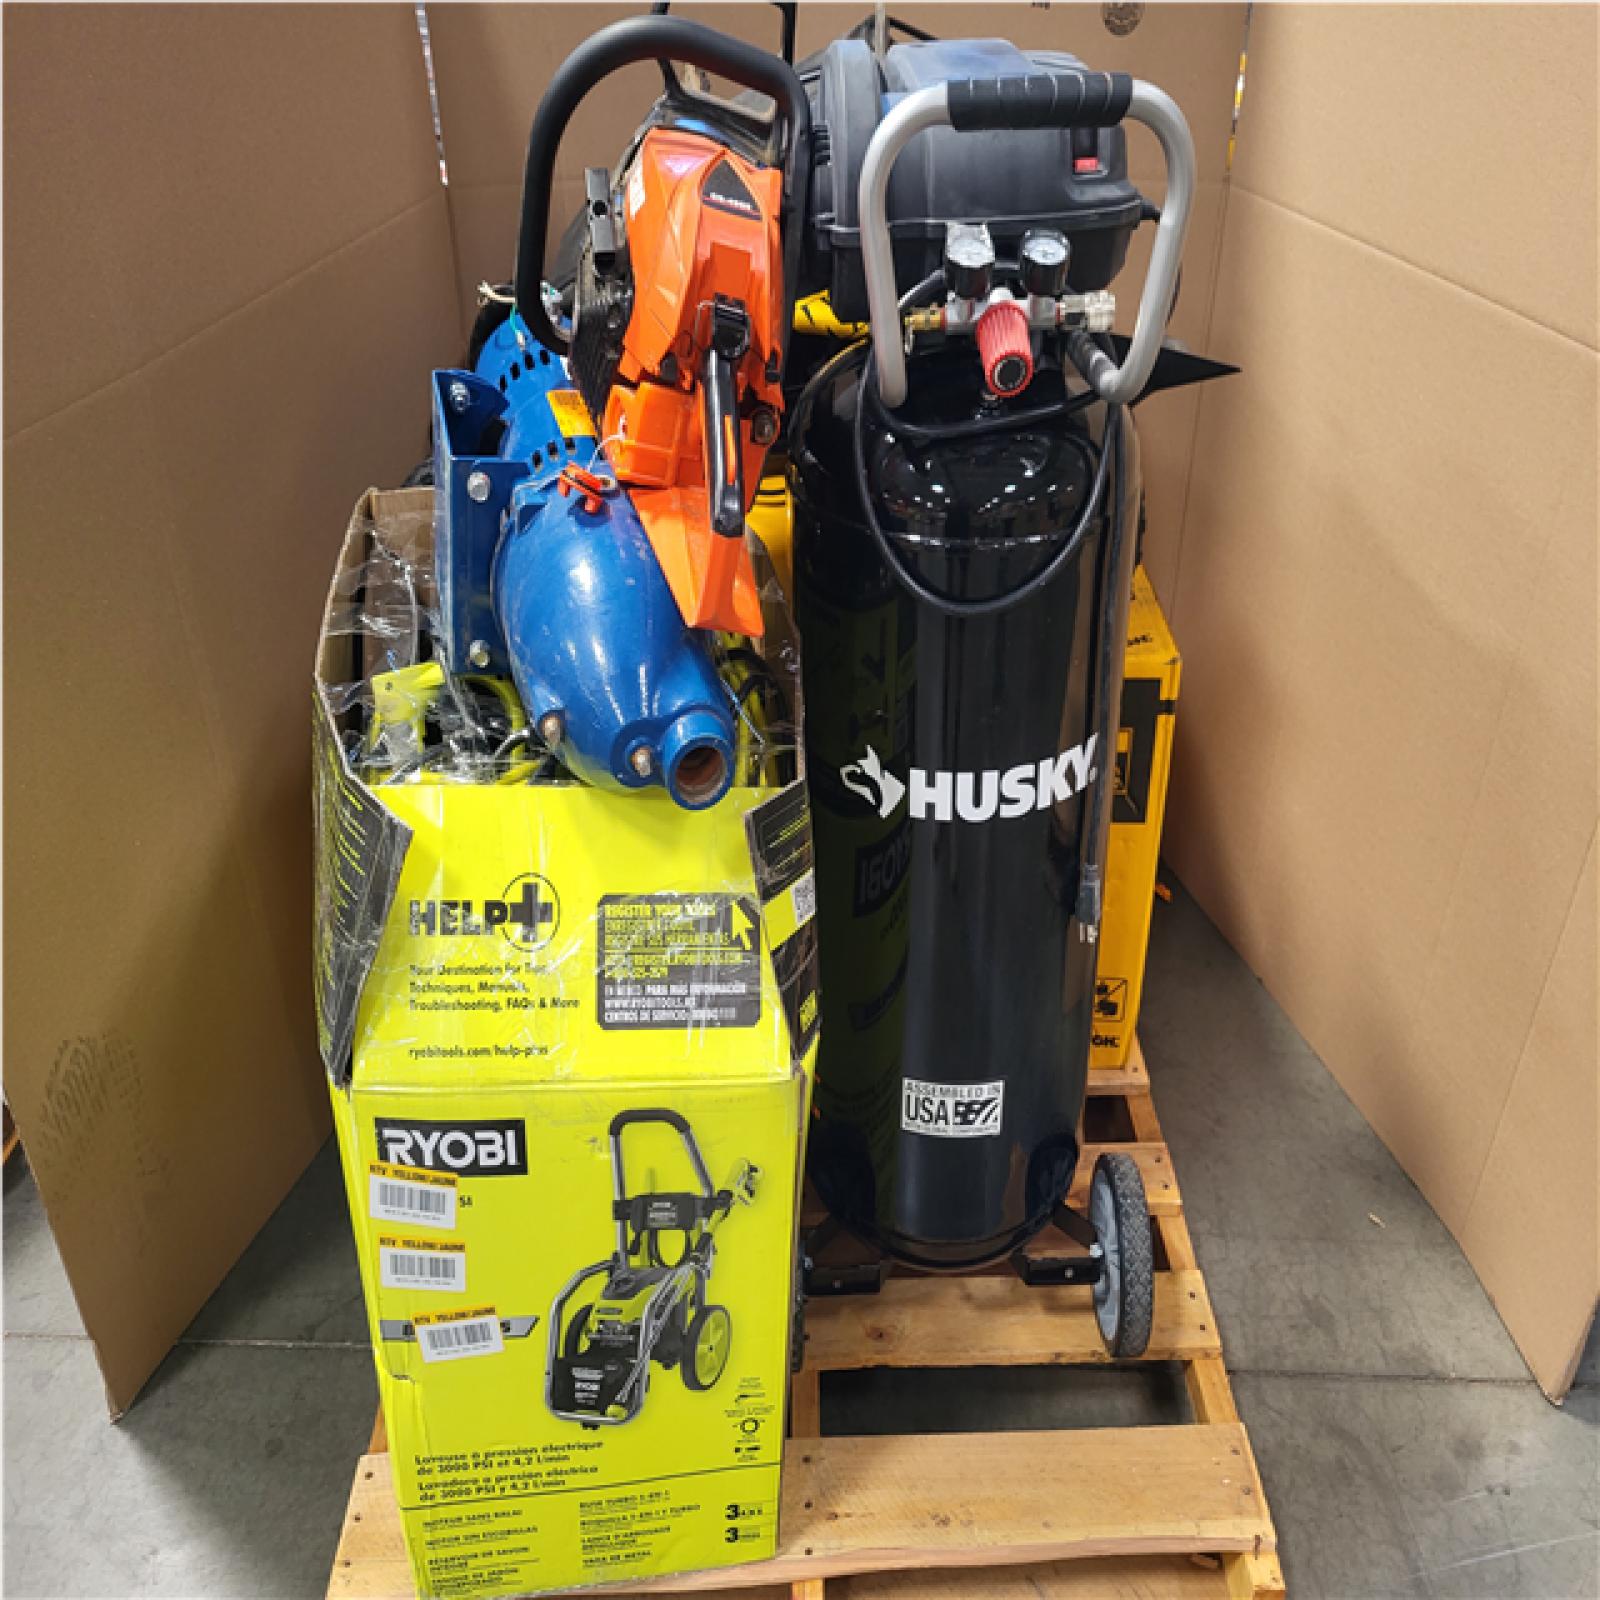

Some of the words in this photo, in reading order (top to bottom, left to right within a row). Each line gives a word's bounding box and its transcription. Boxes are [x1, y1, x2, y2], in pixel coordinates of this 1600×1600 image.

[909, 732, 1097, 823] HUSKY
[904, 1094, 951, 1126] USA
[382, 1129, 517, 1168] RYOBI
[724, 1503, 740, 1520] 3
[724, 1526, 739, 1543] 3
